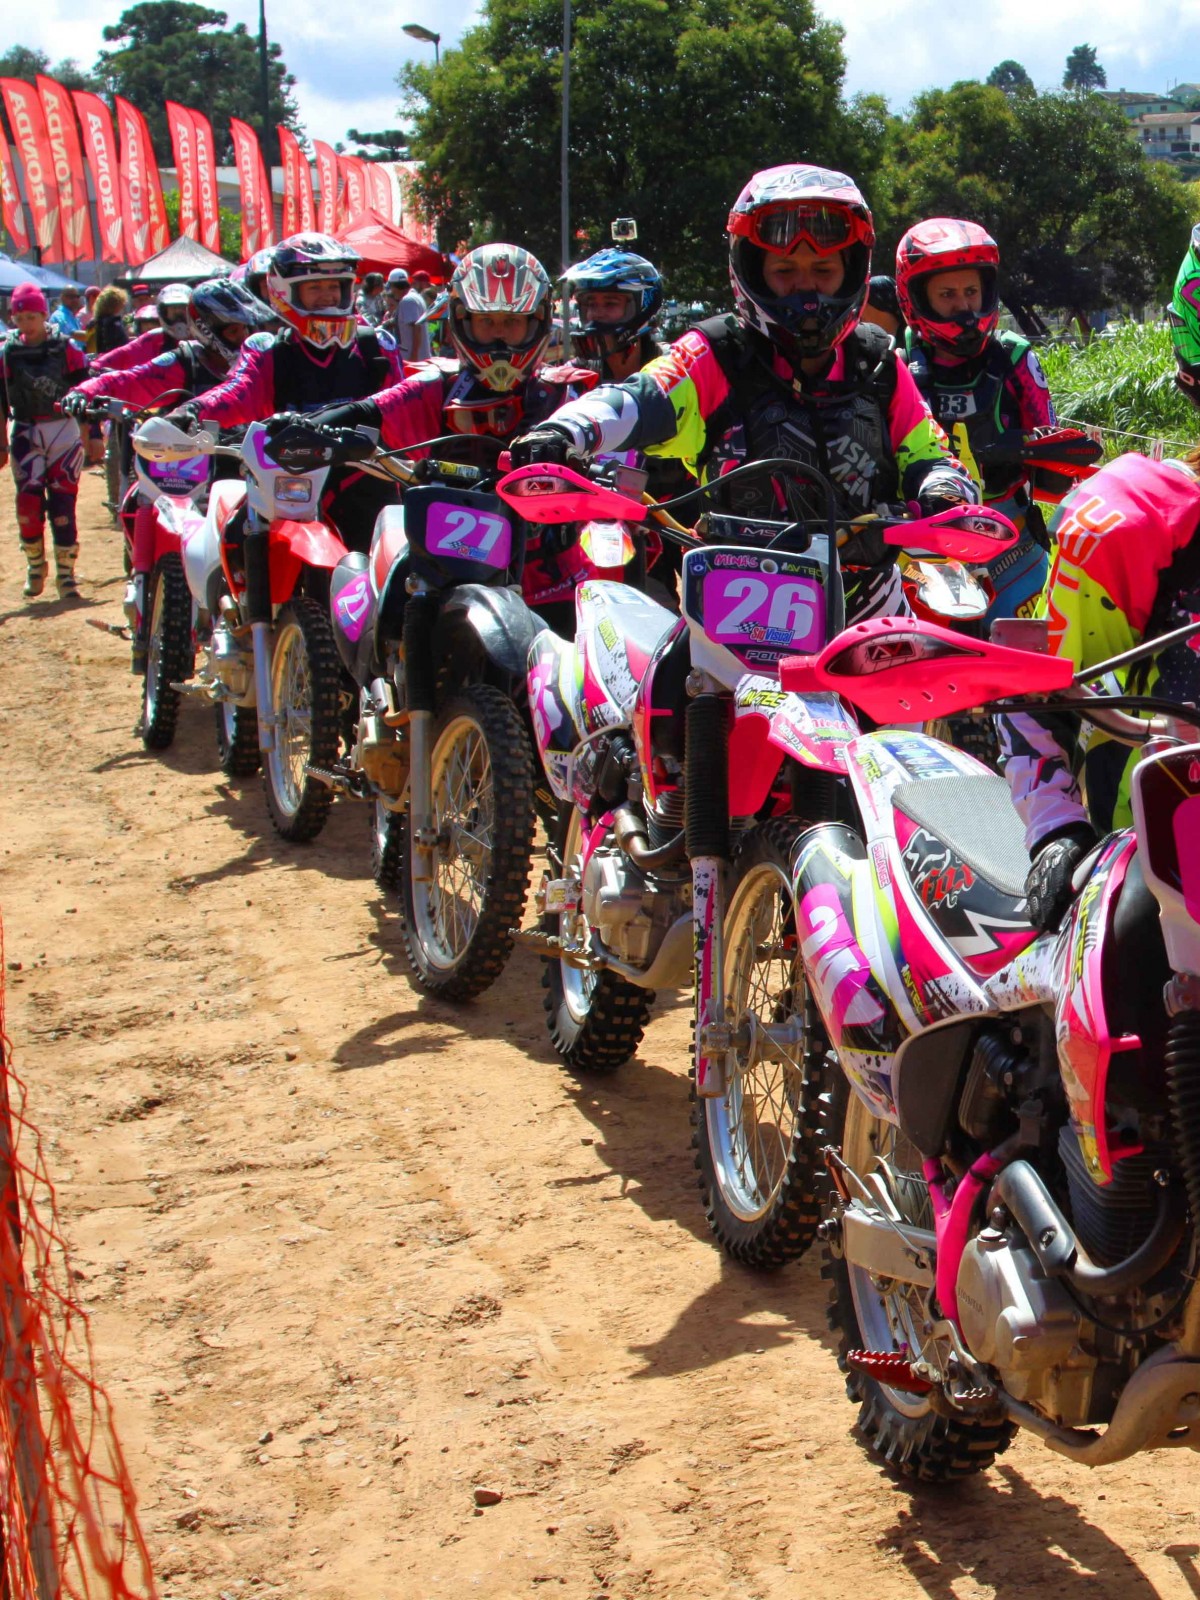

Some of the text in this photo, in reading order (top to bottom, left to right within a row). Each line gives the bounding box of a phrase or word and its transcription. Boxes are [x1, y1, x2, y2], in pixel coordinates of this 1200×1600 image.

[437, 510, 503, 551] 27
[716, 577, 817, 640] 26
[750, 627, 795, 643] SigVisual
[872, 843, 891, 888] SOLANGE
